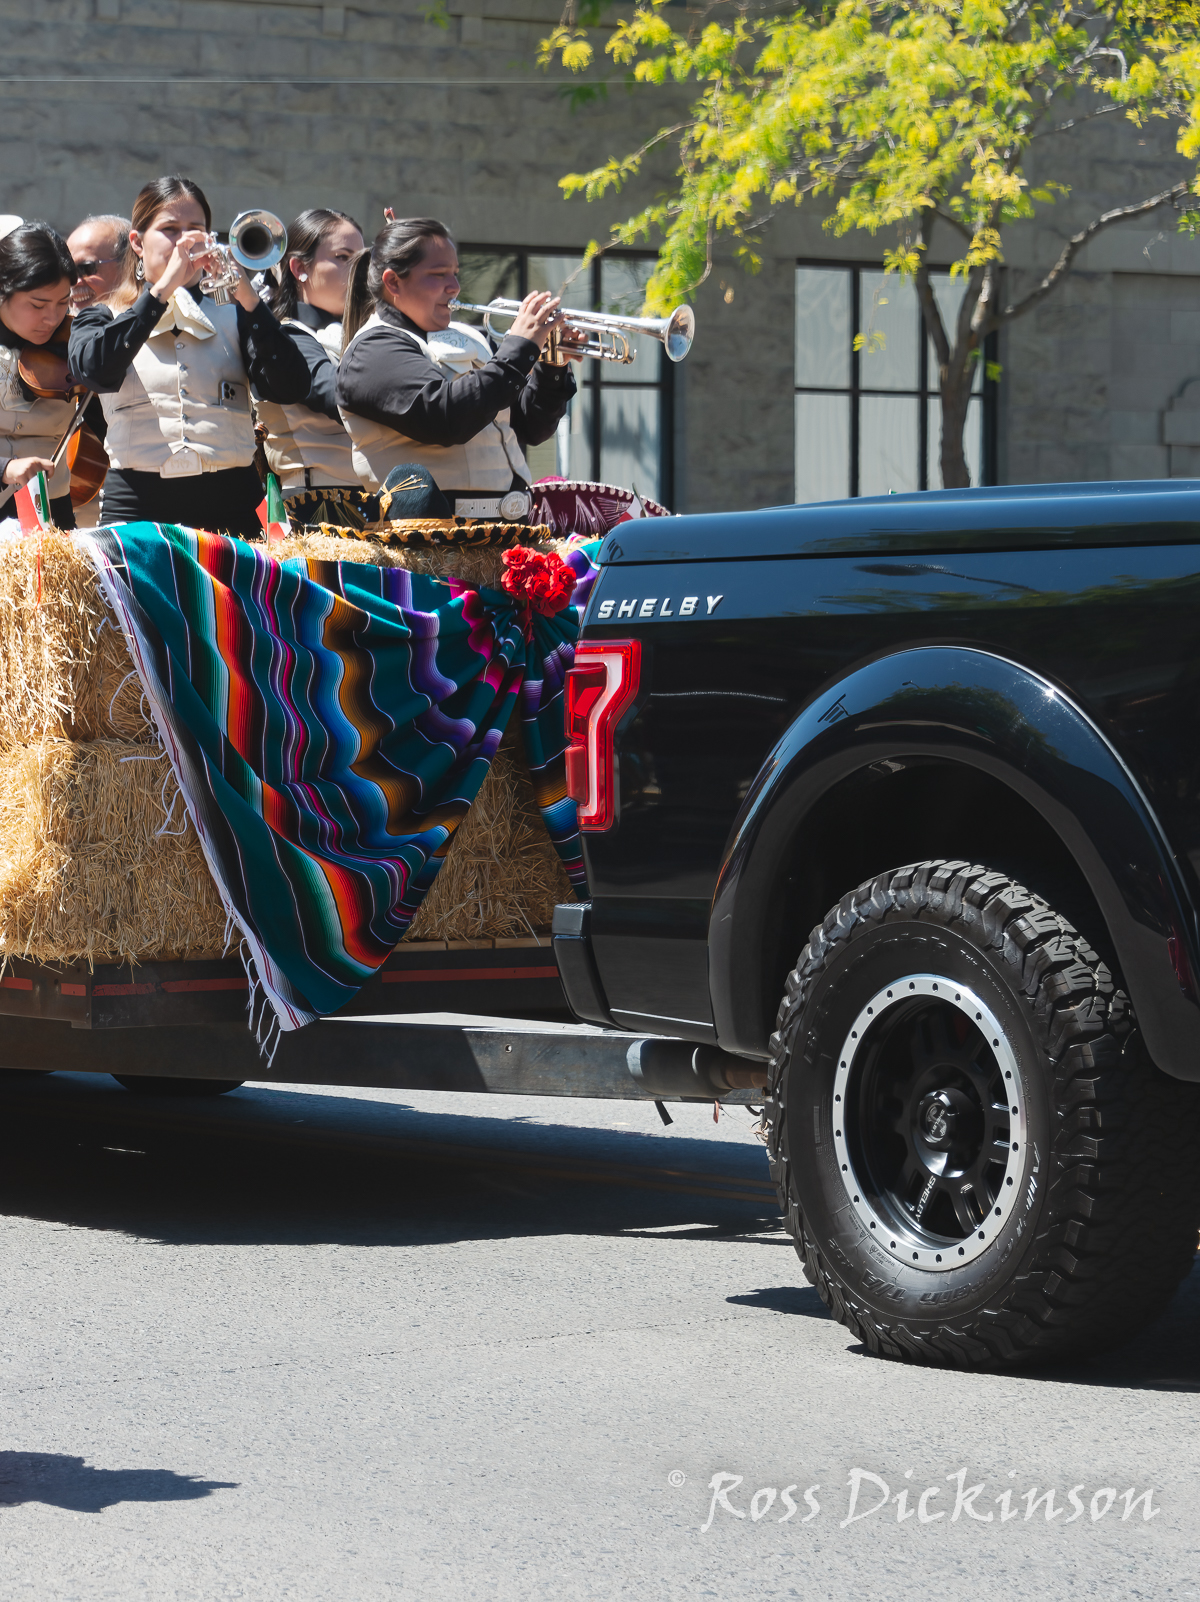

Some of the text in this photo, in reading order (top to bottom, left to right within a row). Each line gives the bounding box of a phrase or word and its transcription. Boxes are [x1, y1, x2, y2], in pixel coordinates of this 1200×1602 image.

[598, 595, 724, 619] SHELBY
[931, 1109, 945, 1134] SHELBY
[914, 1176, 936, 1222] SHELBY
